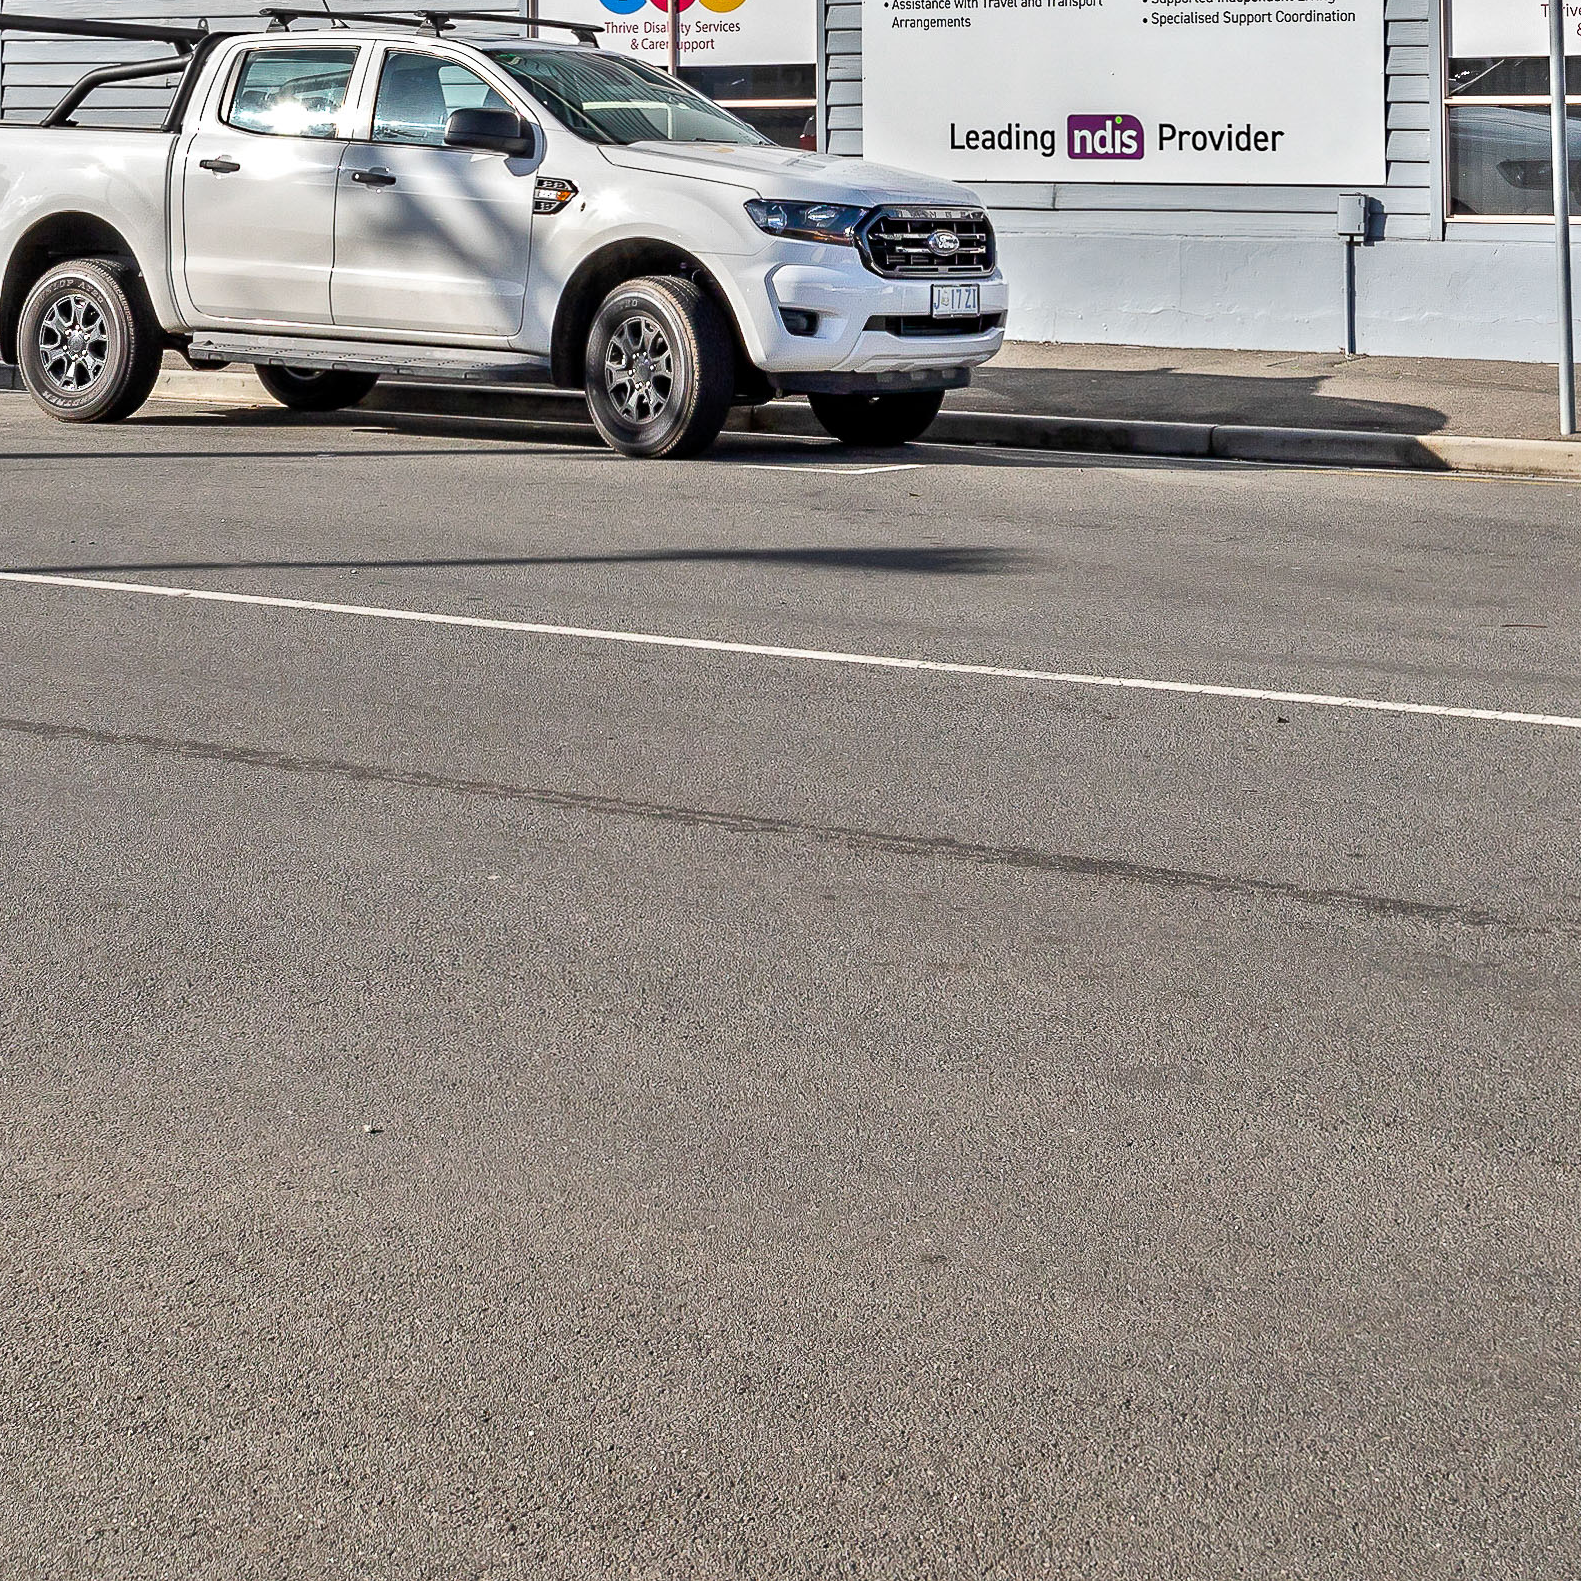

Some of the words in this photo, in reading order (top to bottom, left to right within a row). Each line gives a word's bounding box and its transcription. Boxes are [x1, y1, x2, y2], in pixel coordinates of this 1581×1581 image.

[892, 17, 971, 31] Arrangements
[1151, 12, 1219, 27] Specialised
[1223, 11, 1272, 26] Support
[1276, 10, 1355, 22] Coordination
[604, 22, 639, 33] Thrive
[696, 21, 740, 33] Services
[631, 39, 639, 50] &
[641, 38, 668, 50] Carer
[676, 39, 715, 51] upport
[950, 123, 1056, 157] Leading
[1073, 116, 1138, 155] ndis
[1158, 124, 1284, 153] Provider
